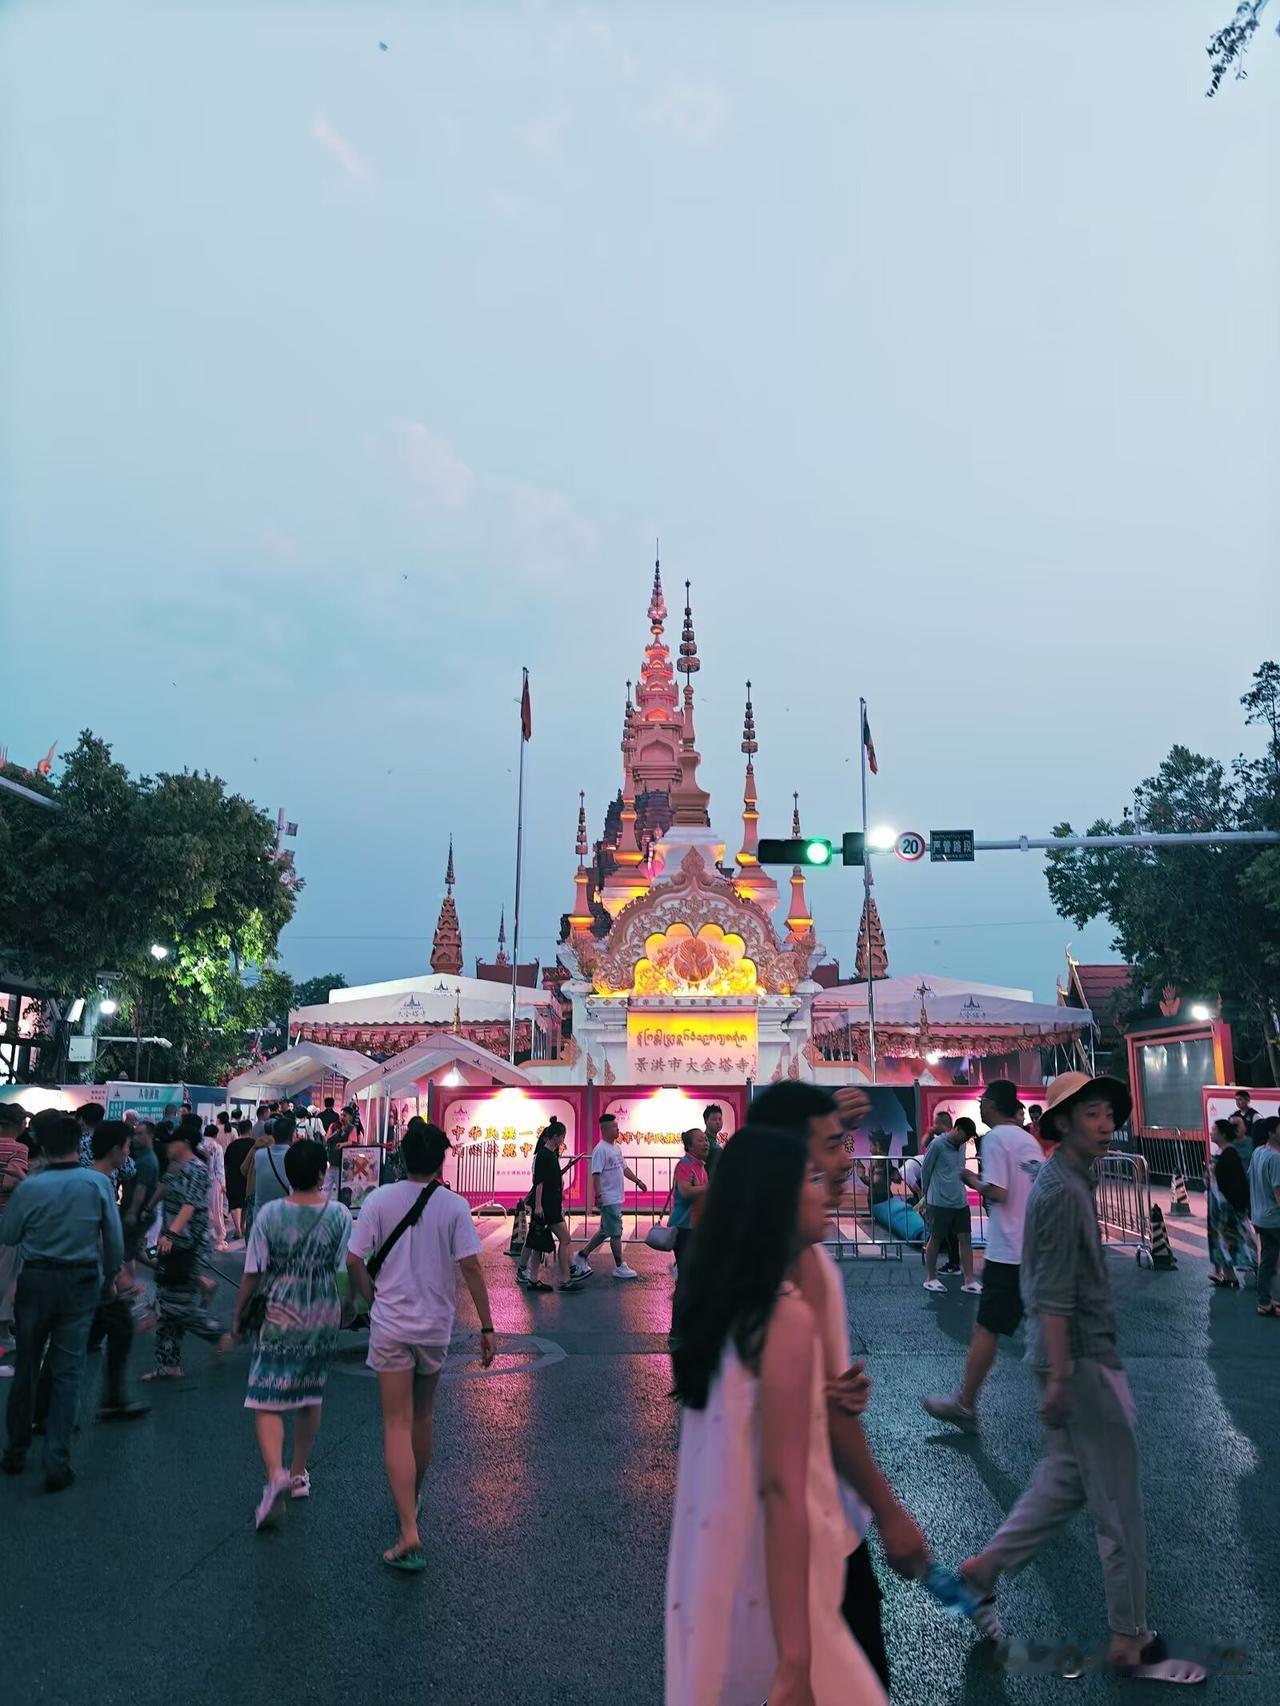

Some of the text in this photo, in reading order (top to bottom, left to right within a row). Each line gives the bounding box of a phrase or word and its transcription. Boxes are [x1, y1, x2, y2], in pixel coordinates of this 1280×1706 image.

[902, 839, 918, 854] 20
[635, 1057, 750, 1073] 景洪市大金塔寺
